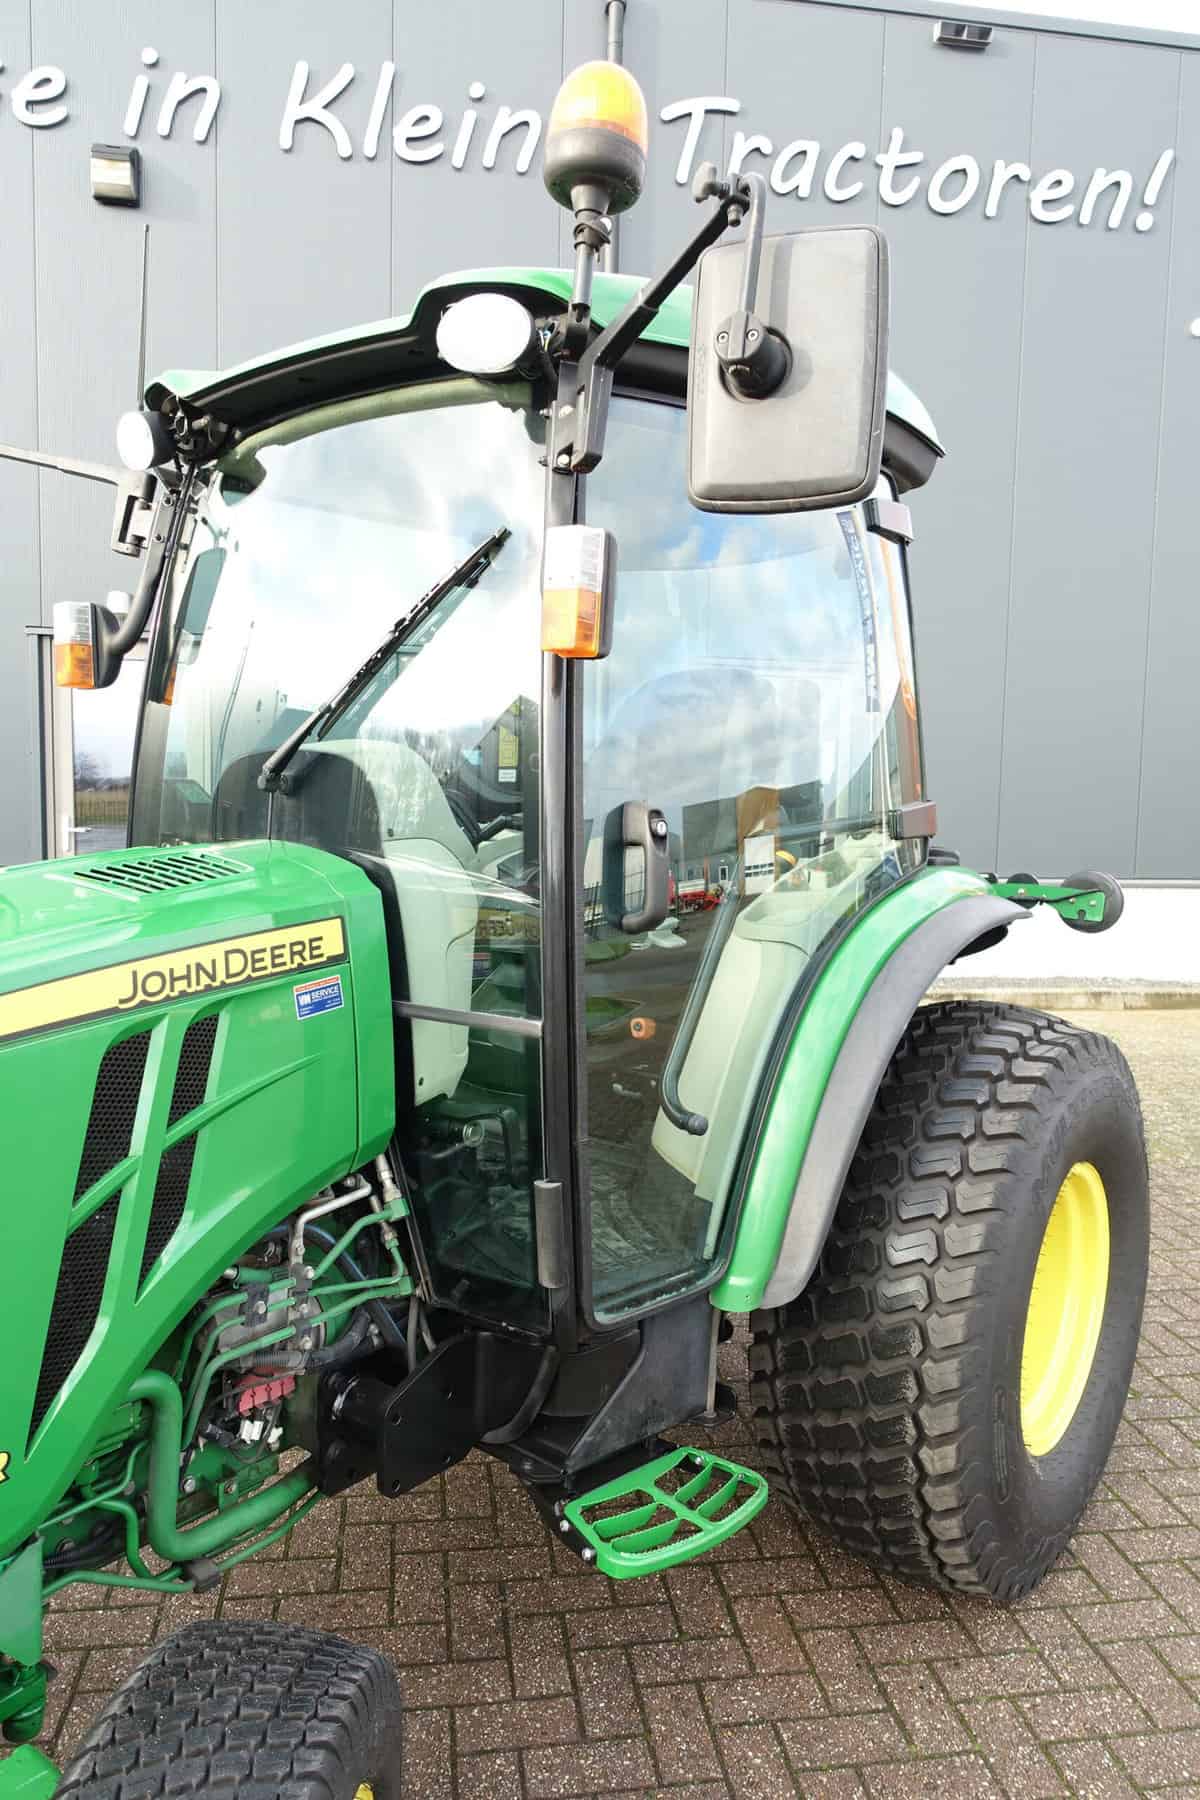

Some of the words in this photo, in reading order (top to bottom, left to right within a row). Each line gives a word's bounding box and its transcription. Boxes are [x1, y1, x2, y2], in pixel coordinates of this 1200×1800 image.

[0, 62, 69, 127] e
[123, 46, 221, 141] in
[278, 60, 543, 174] Klein
[660, 96, 1175, 232] Tractoren!
[118, 957, 217, 1005] JOHN
[224, 935, 324, 979] DEERE
[311, 984, 340, 1001] SERVICE
